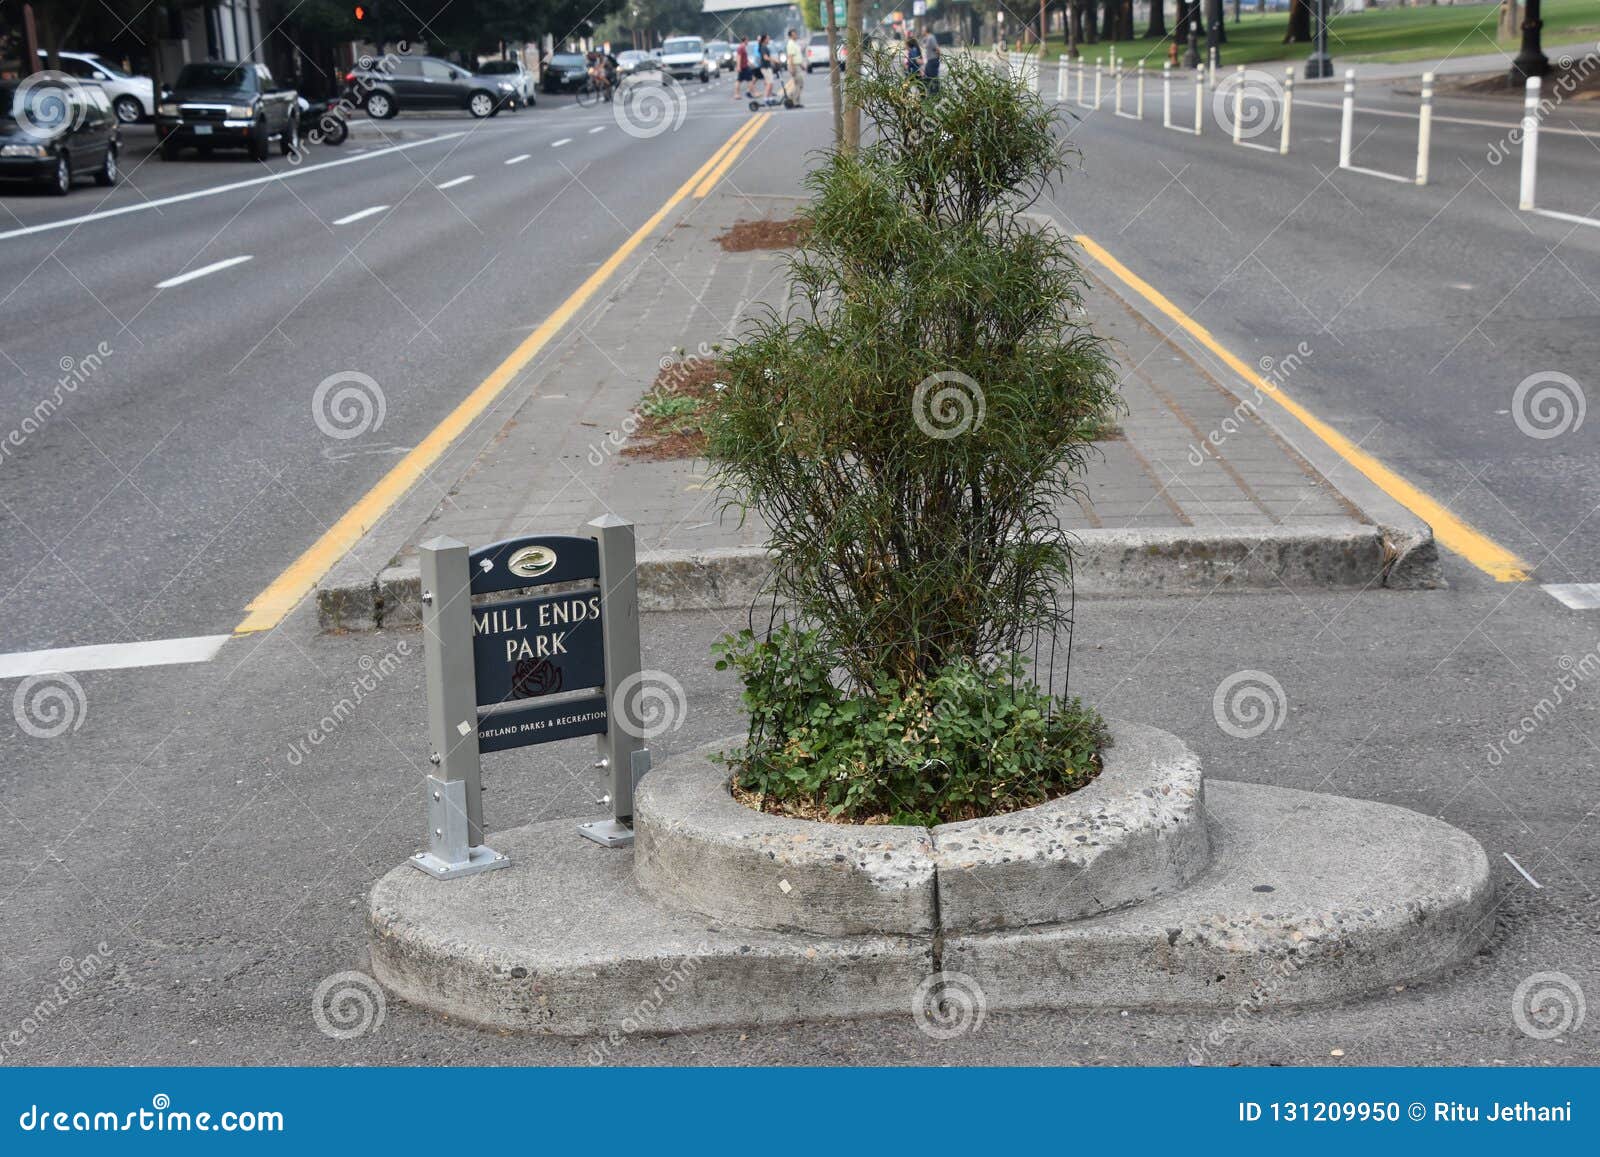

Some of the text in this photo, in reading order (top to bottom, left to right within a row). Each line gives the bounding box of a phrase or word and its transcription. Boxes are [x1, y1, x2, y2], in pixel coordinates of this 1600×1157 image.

[472, 596, 600, 637] MILL ENDS
[505, 631, 568, 662] PARK
[478, 726, 518, 738] ORTLAND
[520, 721, 545, 732] PARKS
[556, 711, 608, 726] RECREATION
